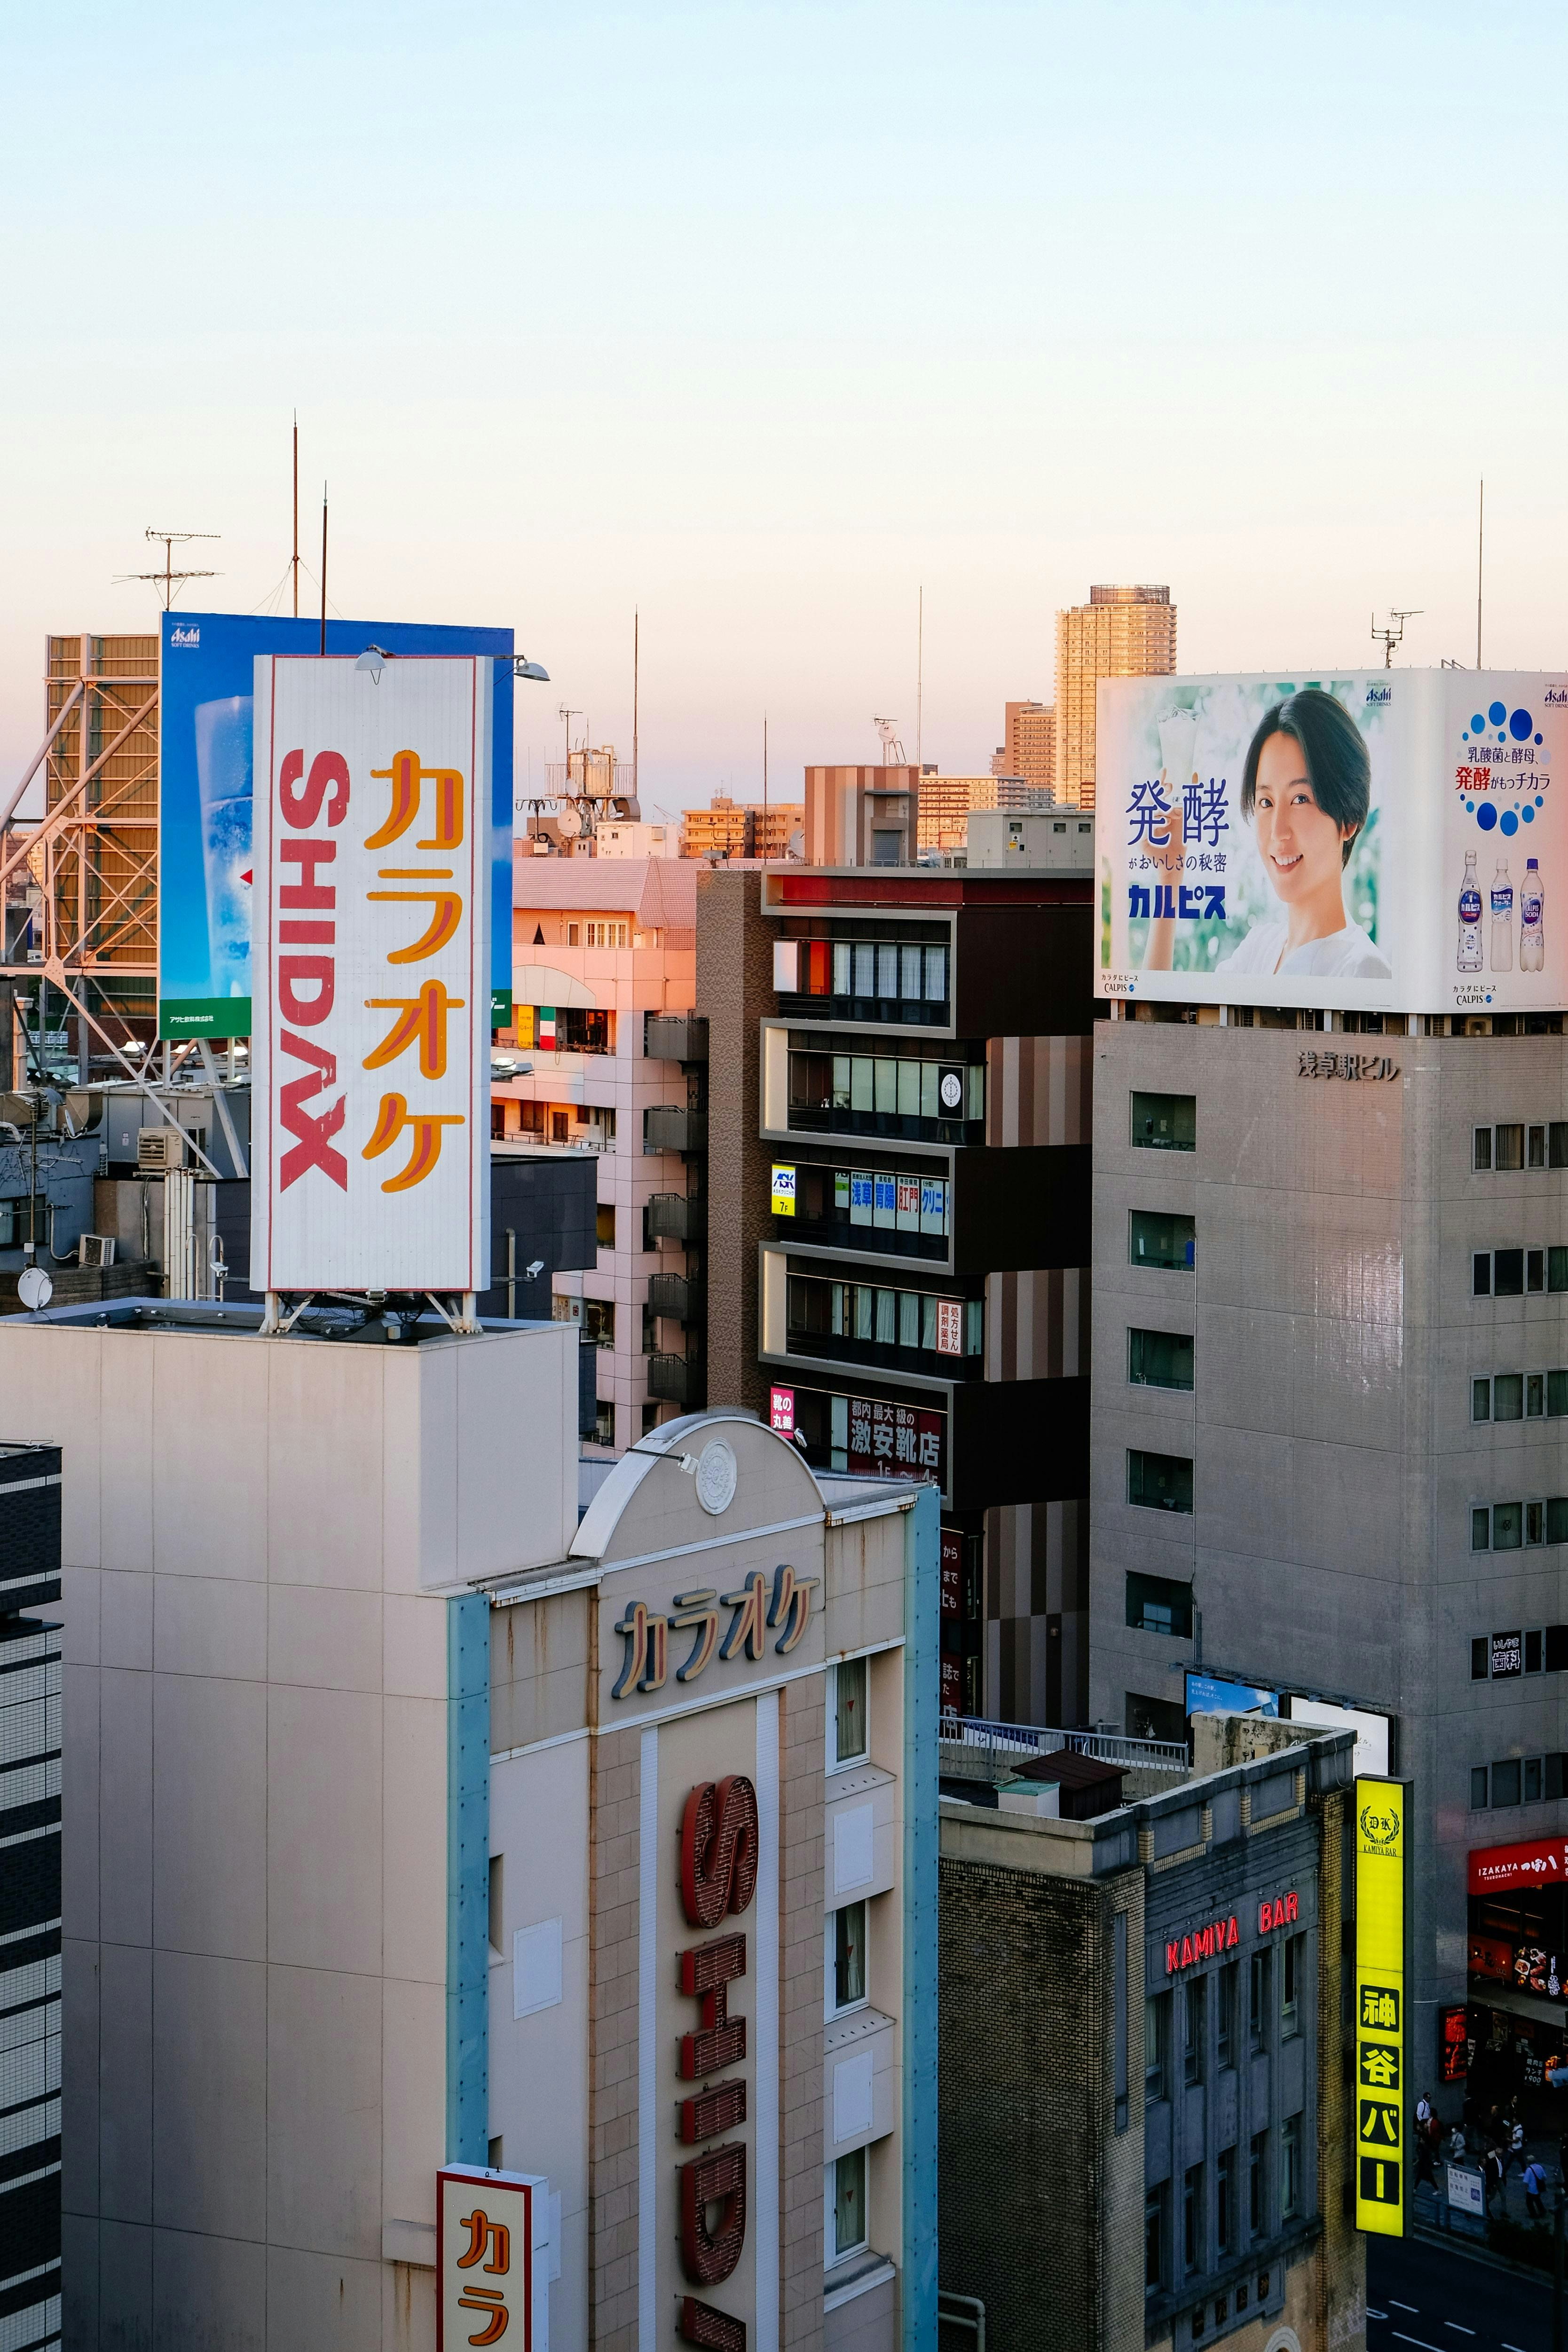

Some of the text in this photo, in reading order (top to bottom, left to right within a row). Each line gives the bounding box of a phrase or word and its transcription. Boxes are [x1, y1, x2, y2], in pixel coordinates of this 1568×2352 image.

[171, 627, 199, 643] Asahi
[1366, 687, 1391, 702] Asahi
[1544, 689, 1568, 702] Asah
[1468, 747, 1538, 765] 乳酸菌と酵母、
[1455, 767, 1550, 790] 発酵がもつチカラ
[1126, 778, 1229, 847] 発酵
[1128, 852, 1227, 873] がおいしさの秘密
[1128, 885, 1226, 920] カルピス
[279, 748, 350, 1193] SHIDAX
[362, 750, 465, 1193] カラオケ
[1104, 983, 1127, 993] CALPIS
[1457, 995, 1483, 1005] CALPIS
[1298, 1050, 1401, 1081] 浅草駅ビル
[780, 1201, 788, 1212] 7F
[773, 1394, 792, 1412] 靴の
[851, 1400, 914, 1425] 都内最大級の
[773, 1414, 792, 1430] 丸善
[851, 1419, 940, 1468] 激安靴店
[943, 1546, 958, 1559] から
[943, 1571, 958, 1584] まで
[612, 1564, 820, 1699] カラオケ
[1492, 1649, 1521, 1672] 歯科
[1363, 1844, 1397, 1857] KAMIYA BAR
[1479, 1863, 1518, 1876] IZAKAYA
[1166, 1891, 1299, 1974] KAMIYA BAR
[1362, 1991, 1399, 2199] 神谷バー
[457, 2209, 510, 2346] カラ
